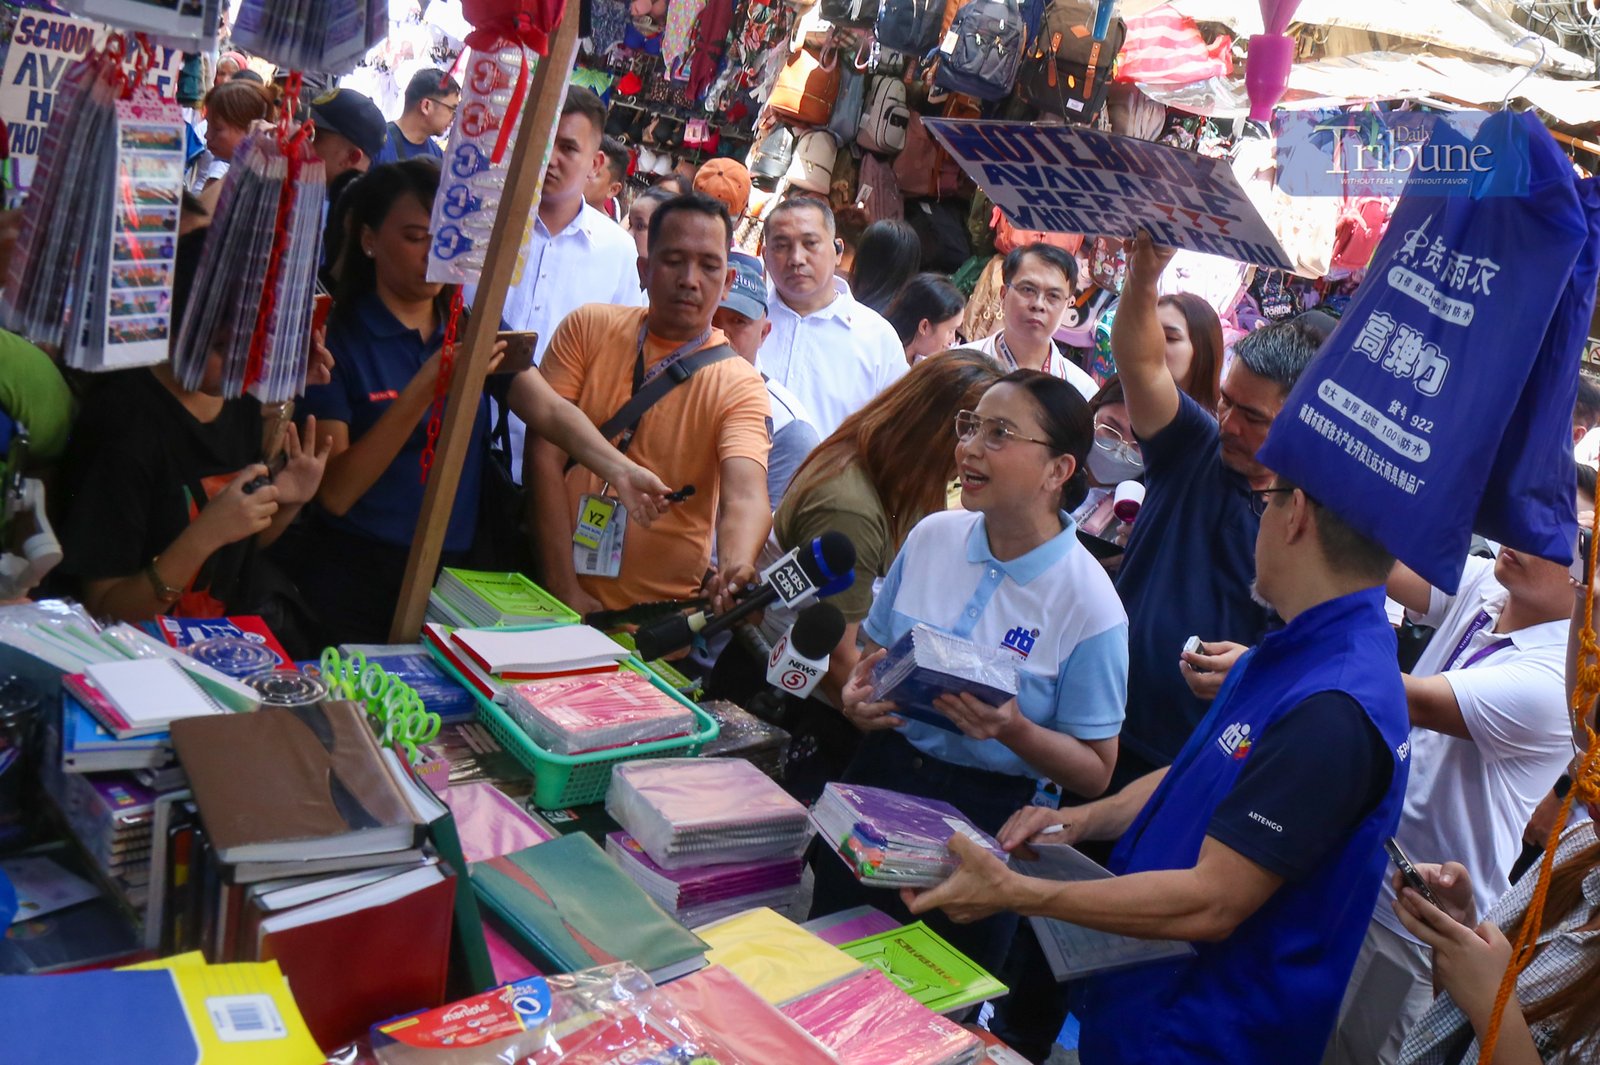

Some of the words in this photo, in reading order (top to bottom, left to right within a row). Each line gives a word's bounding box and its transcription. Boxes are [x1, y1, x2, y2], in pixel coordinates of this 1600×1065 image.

[981, 163, 1243, 222] AVAILABLE
[1183, 226, 1297, 273] RETAIL
[1409, 414, 1434, 435] 922
[589, 509, 605, 528] YZ
[775, 570, 798, 599] CBN
[783, 564, 806, 592] ABS
[788, 659, 818, 678] NEWS
[1248, 810, 1283, 833] ARTENGO
